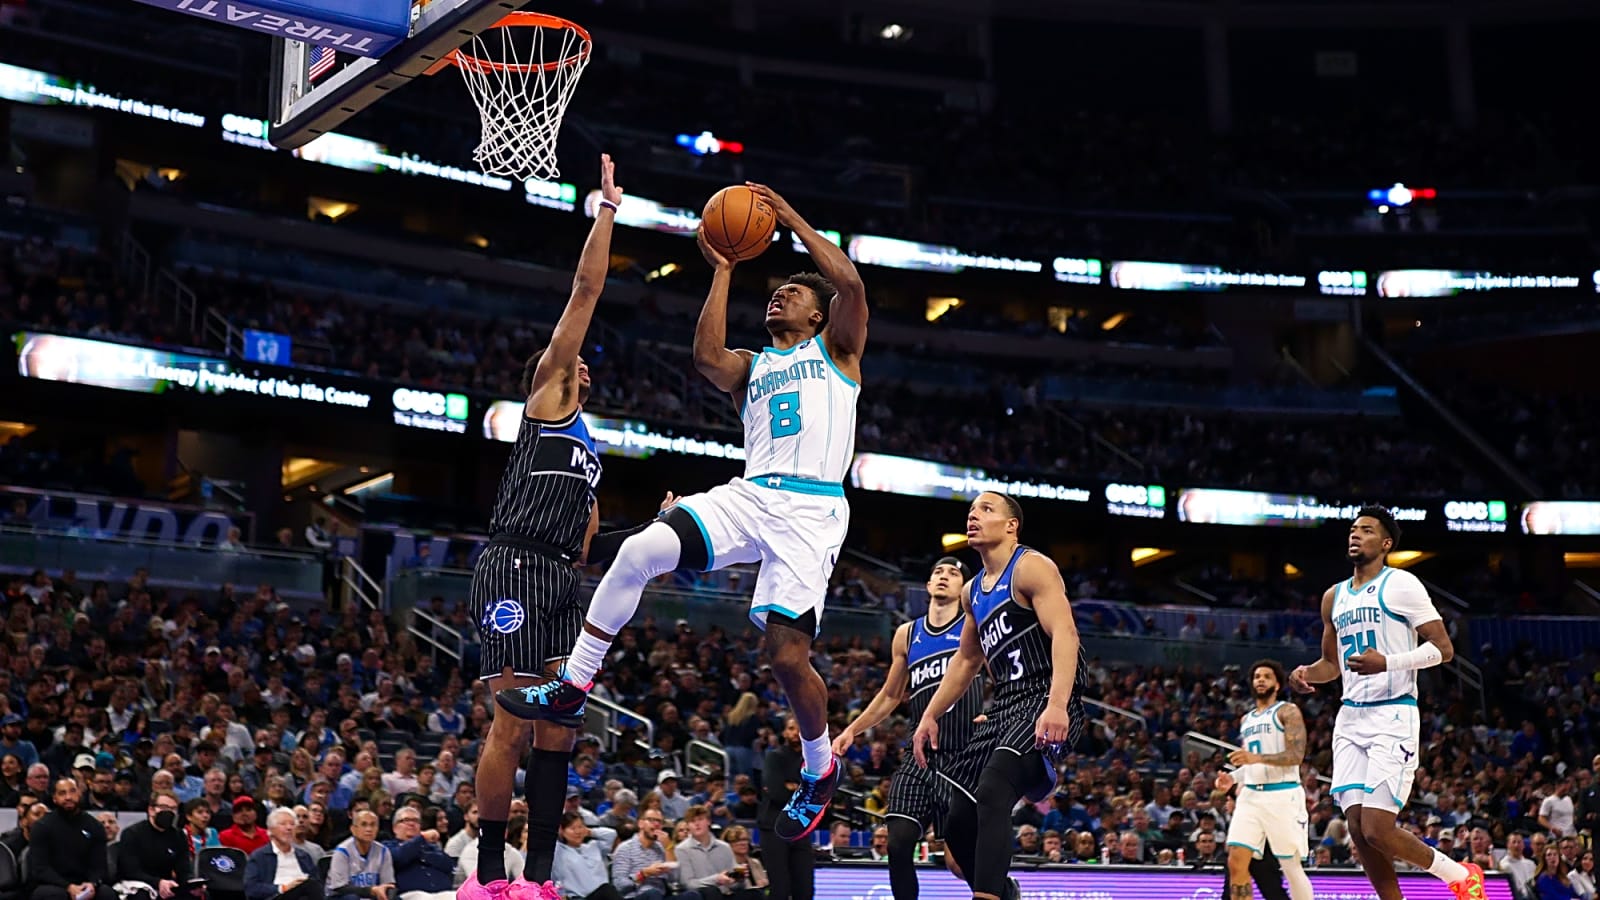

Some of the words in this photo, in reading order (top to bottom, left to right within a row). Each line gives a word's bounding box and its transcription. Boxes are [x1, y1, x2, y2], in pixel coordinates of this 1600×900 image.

[199, 369, 258, 394] Provider
[259, 378, 275, 396] of
[275, 380, 300, 399] the
[301, 383, 324, 402] Kia
[325, 387, 370, 408] Center
[769, 391, 802, 439] 8
[1007, 648, 1024, 681] 3
[1340, 629, 1377, 671] 24
